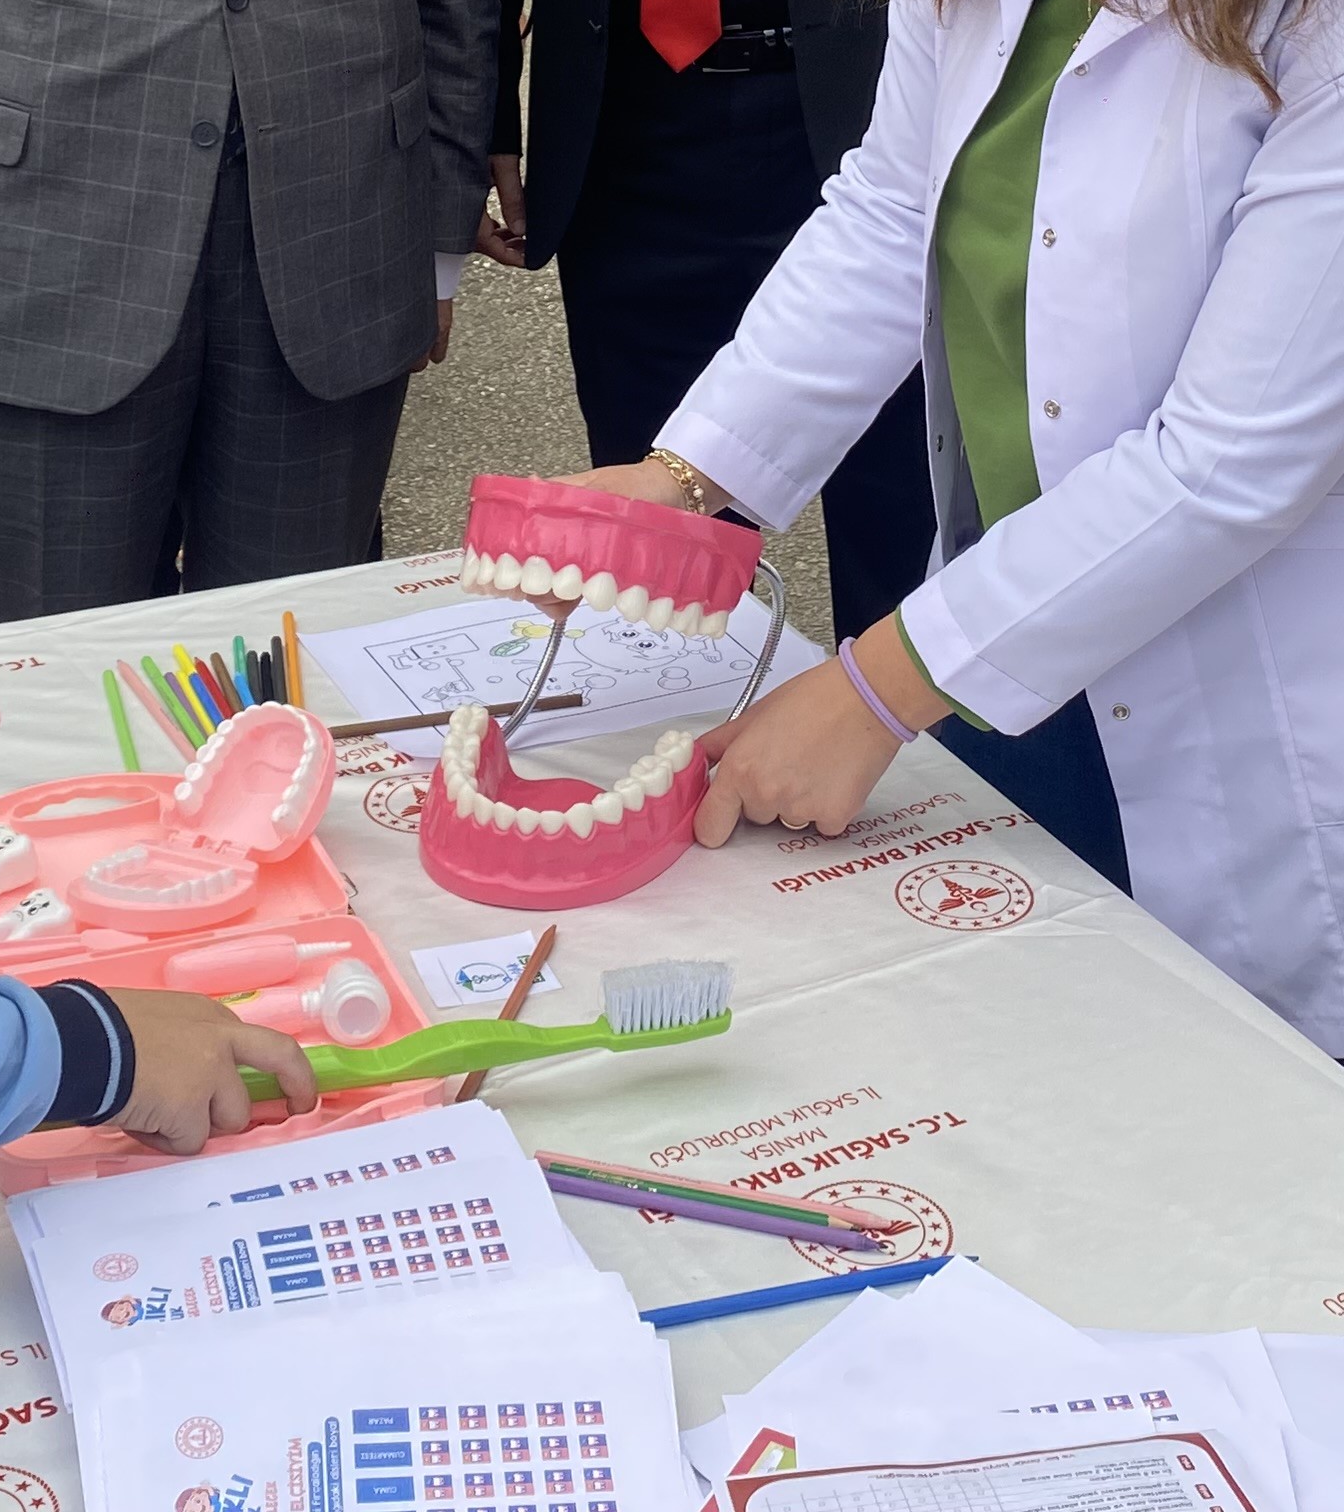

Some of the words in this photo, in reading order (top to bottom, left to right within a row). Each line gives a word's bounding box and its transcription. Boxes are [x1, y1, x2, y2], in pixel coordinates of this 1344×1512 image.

[883, 794, 949, 825] SAĞLIK
[989, 812, 1035, 829] T.C.
[905, 820, 993, 858] SAĞLIK
[772, 848, 909, 893] BAKANLIĞI
[783, 1092, 860, 1124] SAĞLIK
[857, 1086, 882, 1100] İL
[908, 1112, 967, 1136] T.C.
[649, 1114, 786, 1168] MÜDÜRLÜĞÜ
[741, 1126, 828, 1161] MANİSA
[803, 1128, 910, 1172] SAĞLIK
[21, 1342, 48, 1360] İL
[368, 1416, 394, 1426] PAZAR
[372, 1486, 397, 1494] CUMA
